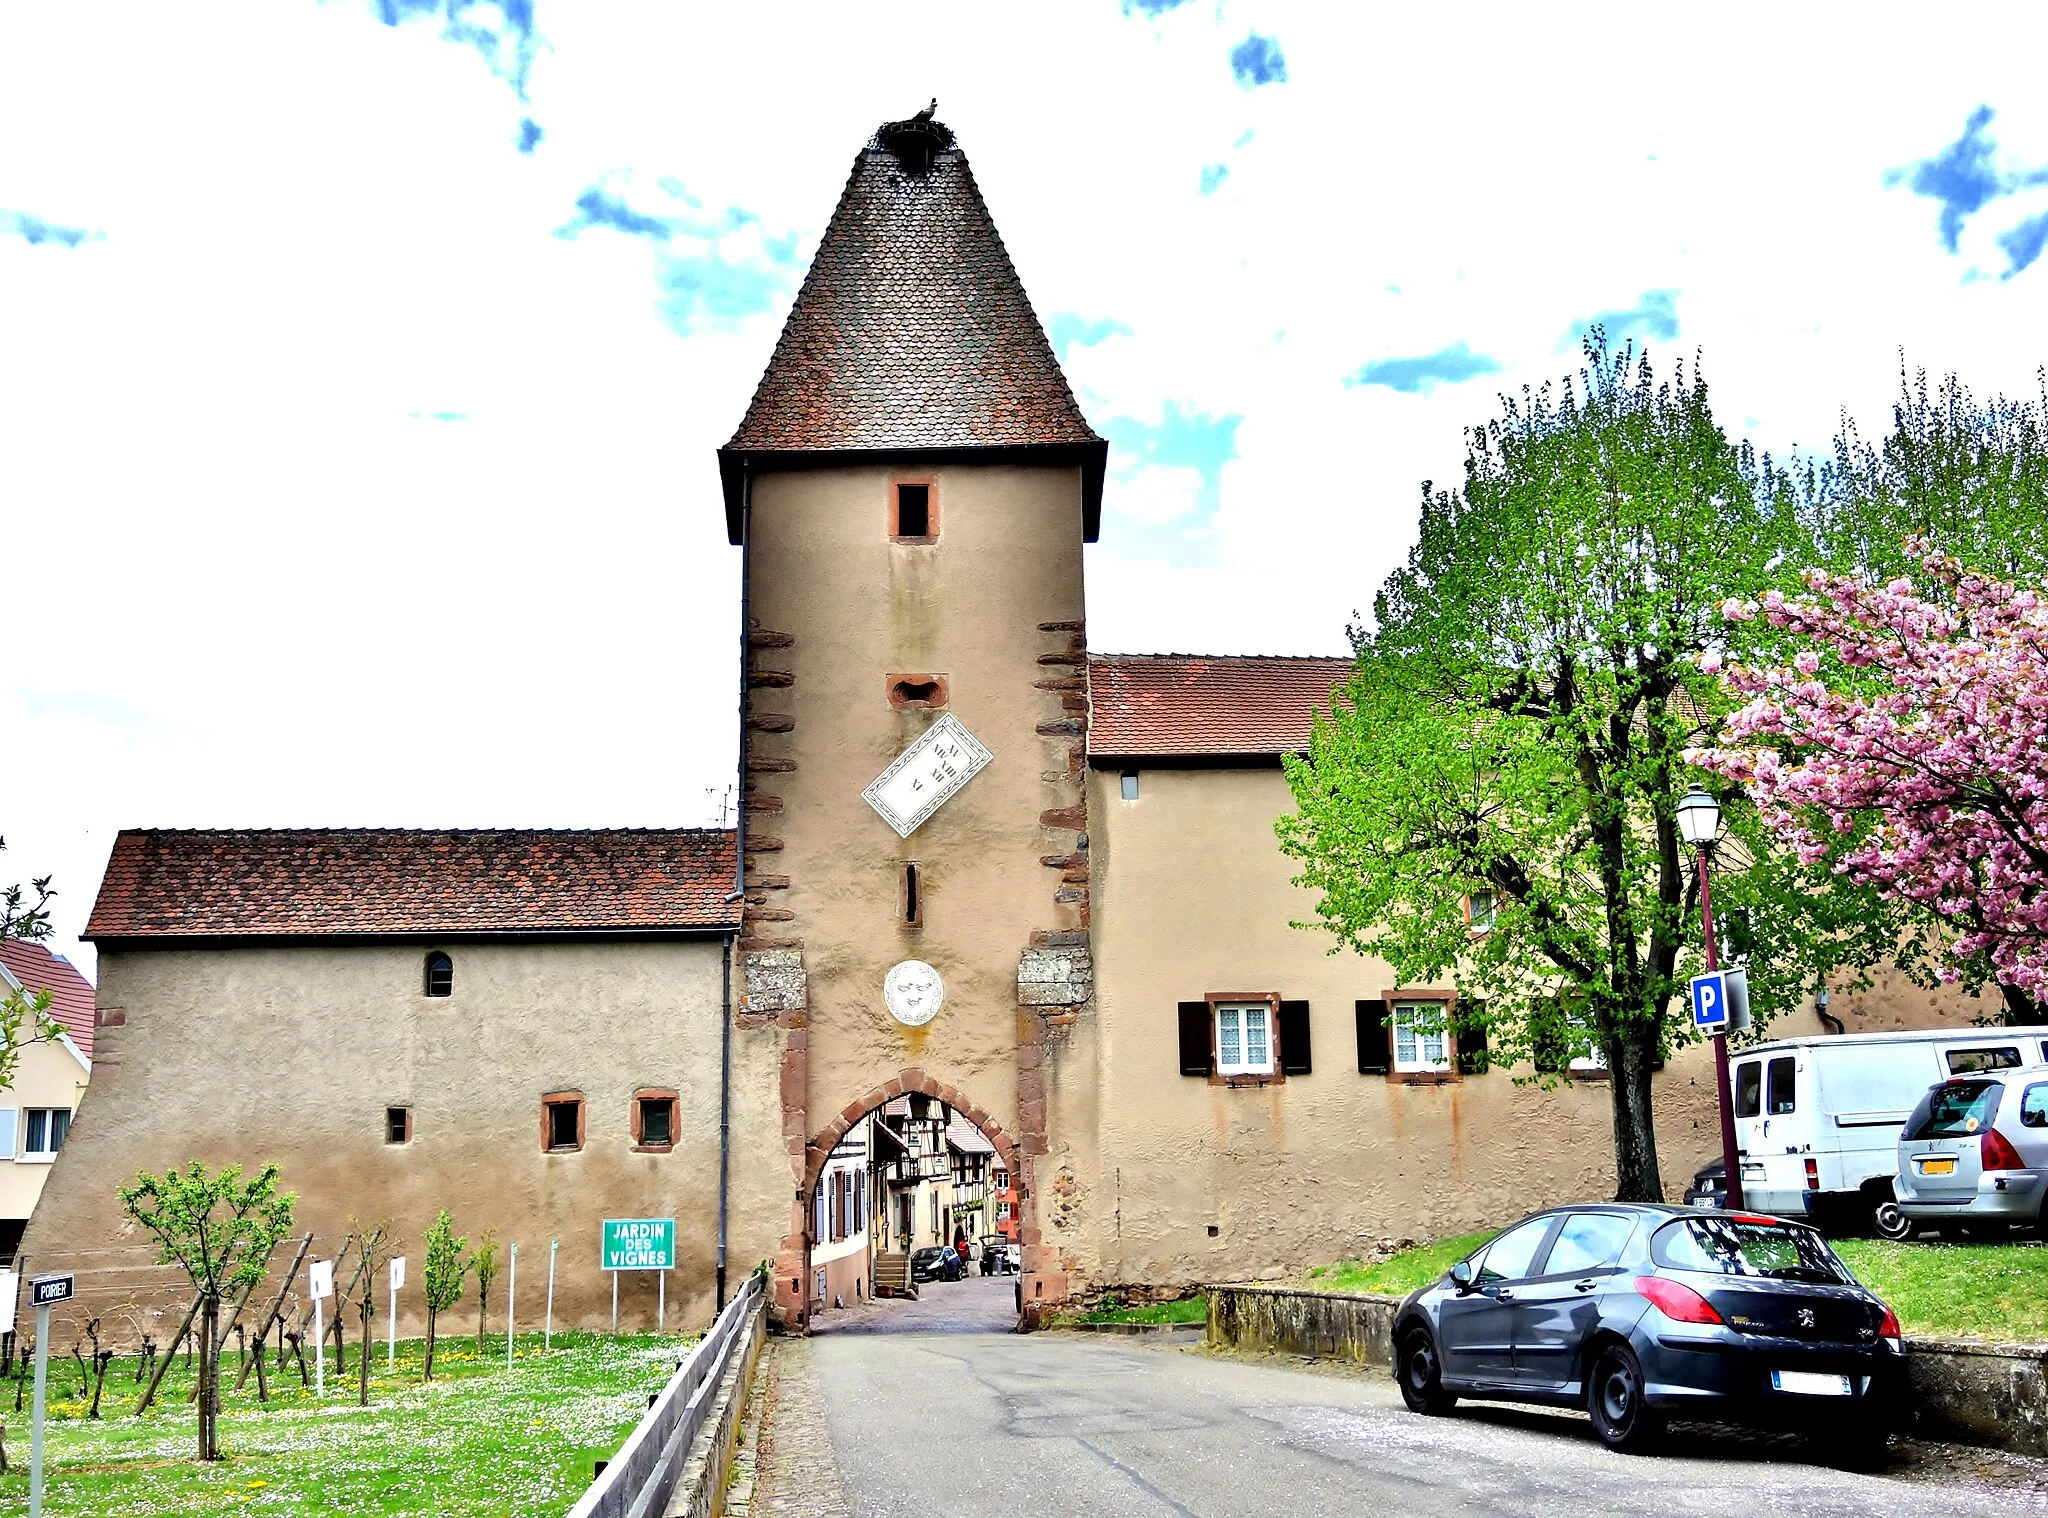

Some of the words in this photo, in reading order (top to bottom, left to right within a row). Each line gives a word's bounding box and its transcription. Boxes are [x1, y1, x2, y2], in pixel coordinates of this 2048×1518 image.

[930, 768, 945, 782] XII
[910, 778, 923, 791] XI
[1700, 985, 1715, 1016] P
[613, 1224, 664, 1238] JARDIN
[625, 1239, 652, 1251] DES
[610, 1251, 667, 1265] VIGNES
[41, 1282, 66, 1299] POIRIER
